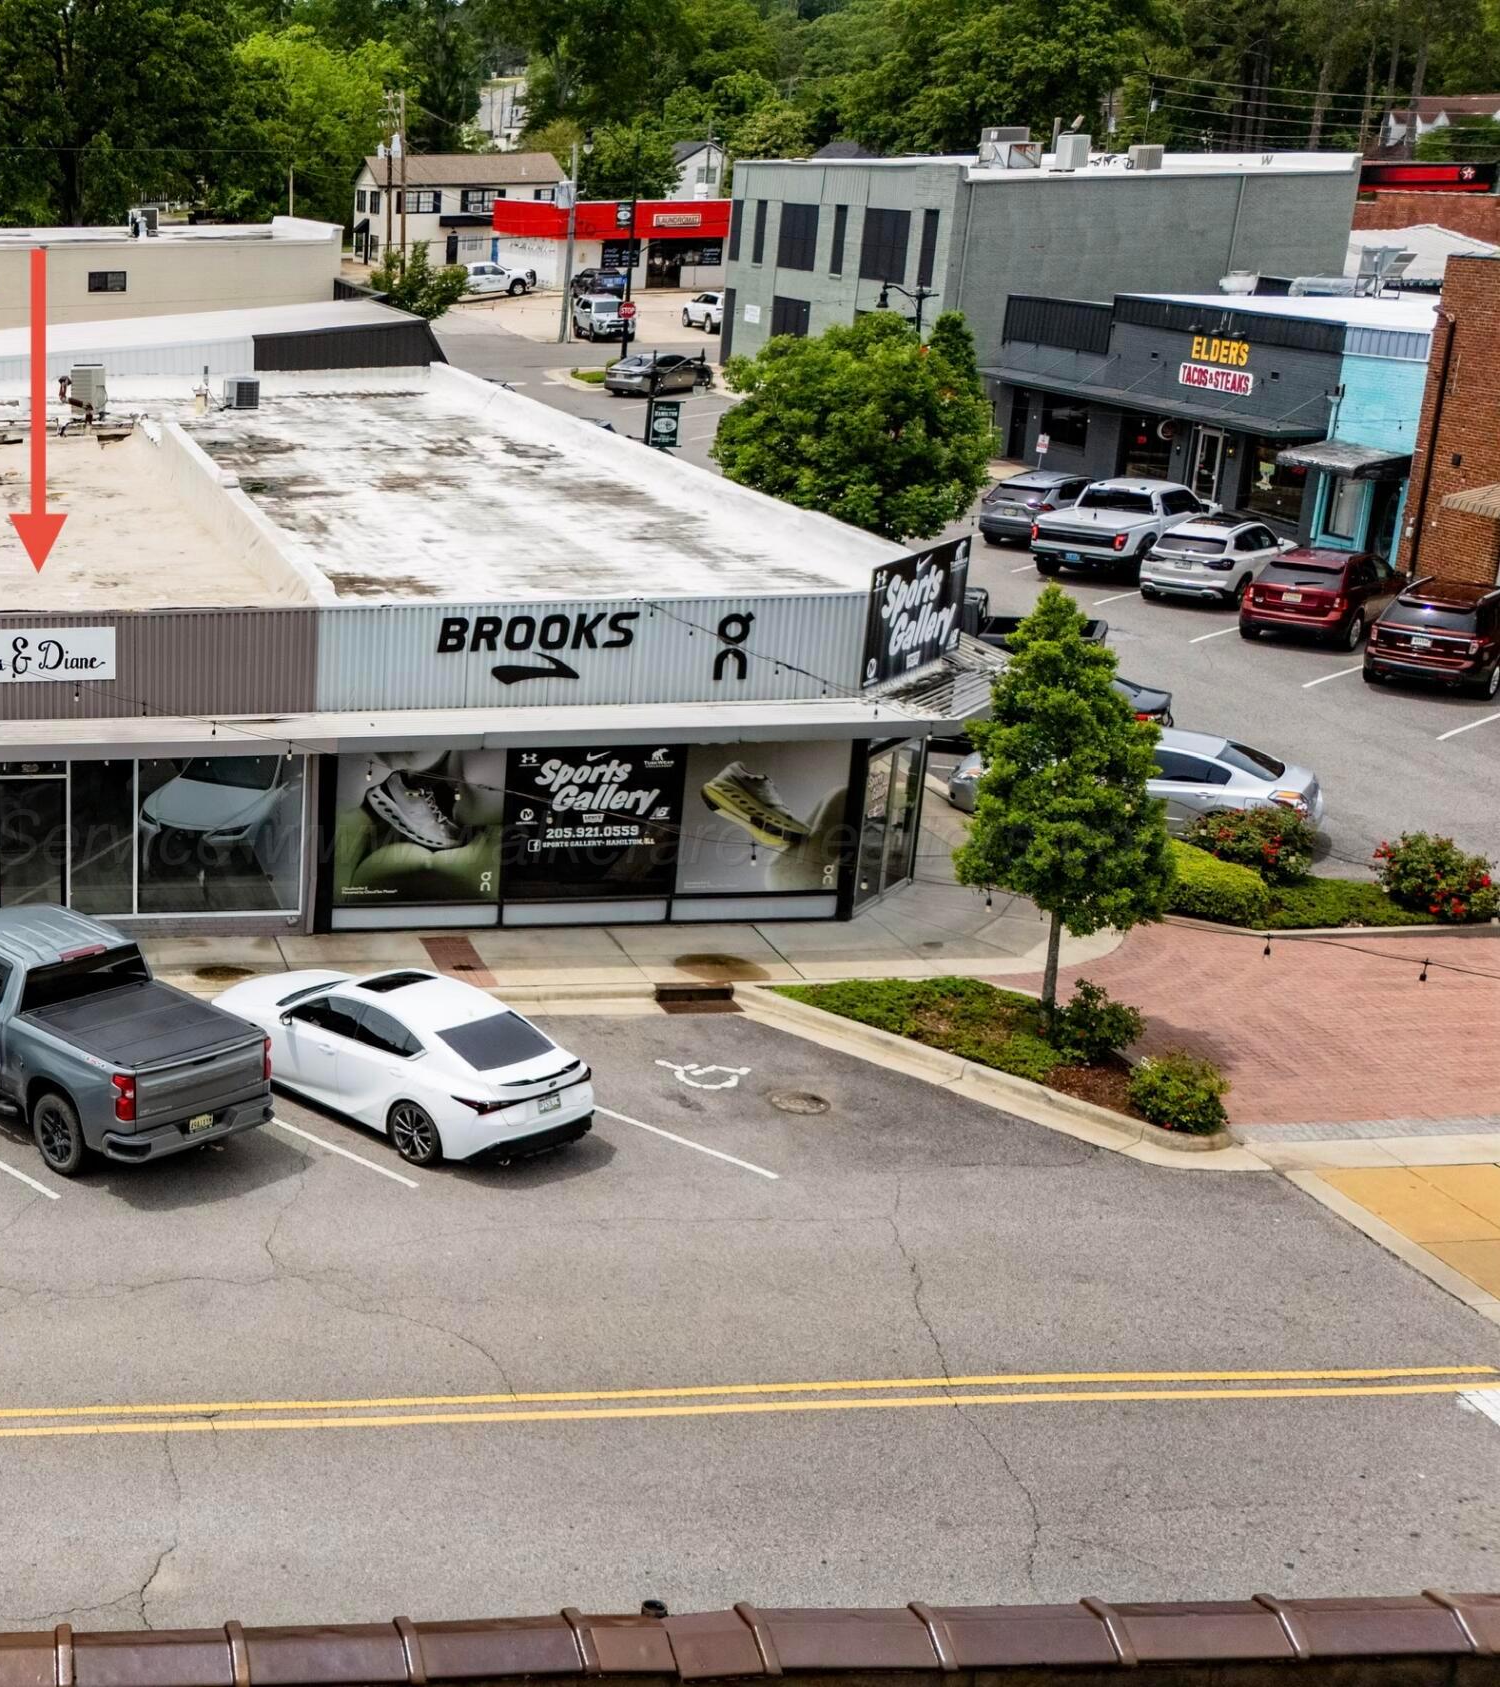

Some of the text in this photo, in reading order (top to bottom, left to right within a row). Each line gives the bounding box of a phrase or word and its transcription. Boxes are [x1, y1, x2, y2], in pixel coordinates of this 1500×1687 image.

[656, 214, 699, 226] LAUNDROMAT
[619, 306, 636, 316] STOP
[1191, 336, 1250, 366] ELDER'S
[1182, 365, 1209, 387] TACOS
[1214, 372, 1250, 395] STEAKS
[881, 564, 944, 628] Sports
[437, 611, 641, 653] BROOKS
[888, 602, 958, 656] Gallery
[11, 636, 32, 675] &
[37, 639, 107, 671] Diane
[535, 758, 632, 793] Sports
[552, 784, 661, 815] Gallery
[542, 841, 569, 849] SPORTS
[546, 825, 640, 839] 205.921.0559
